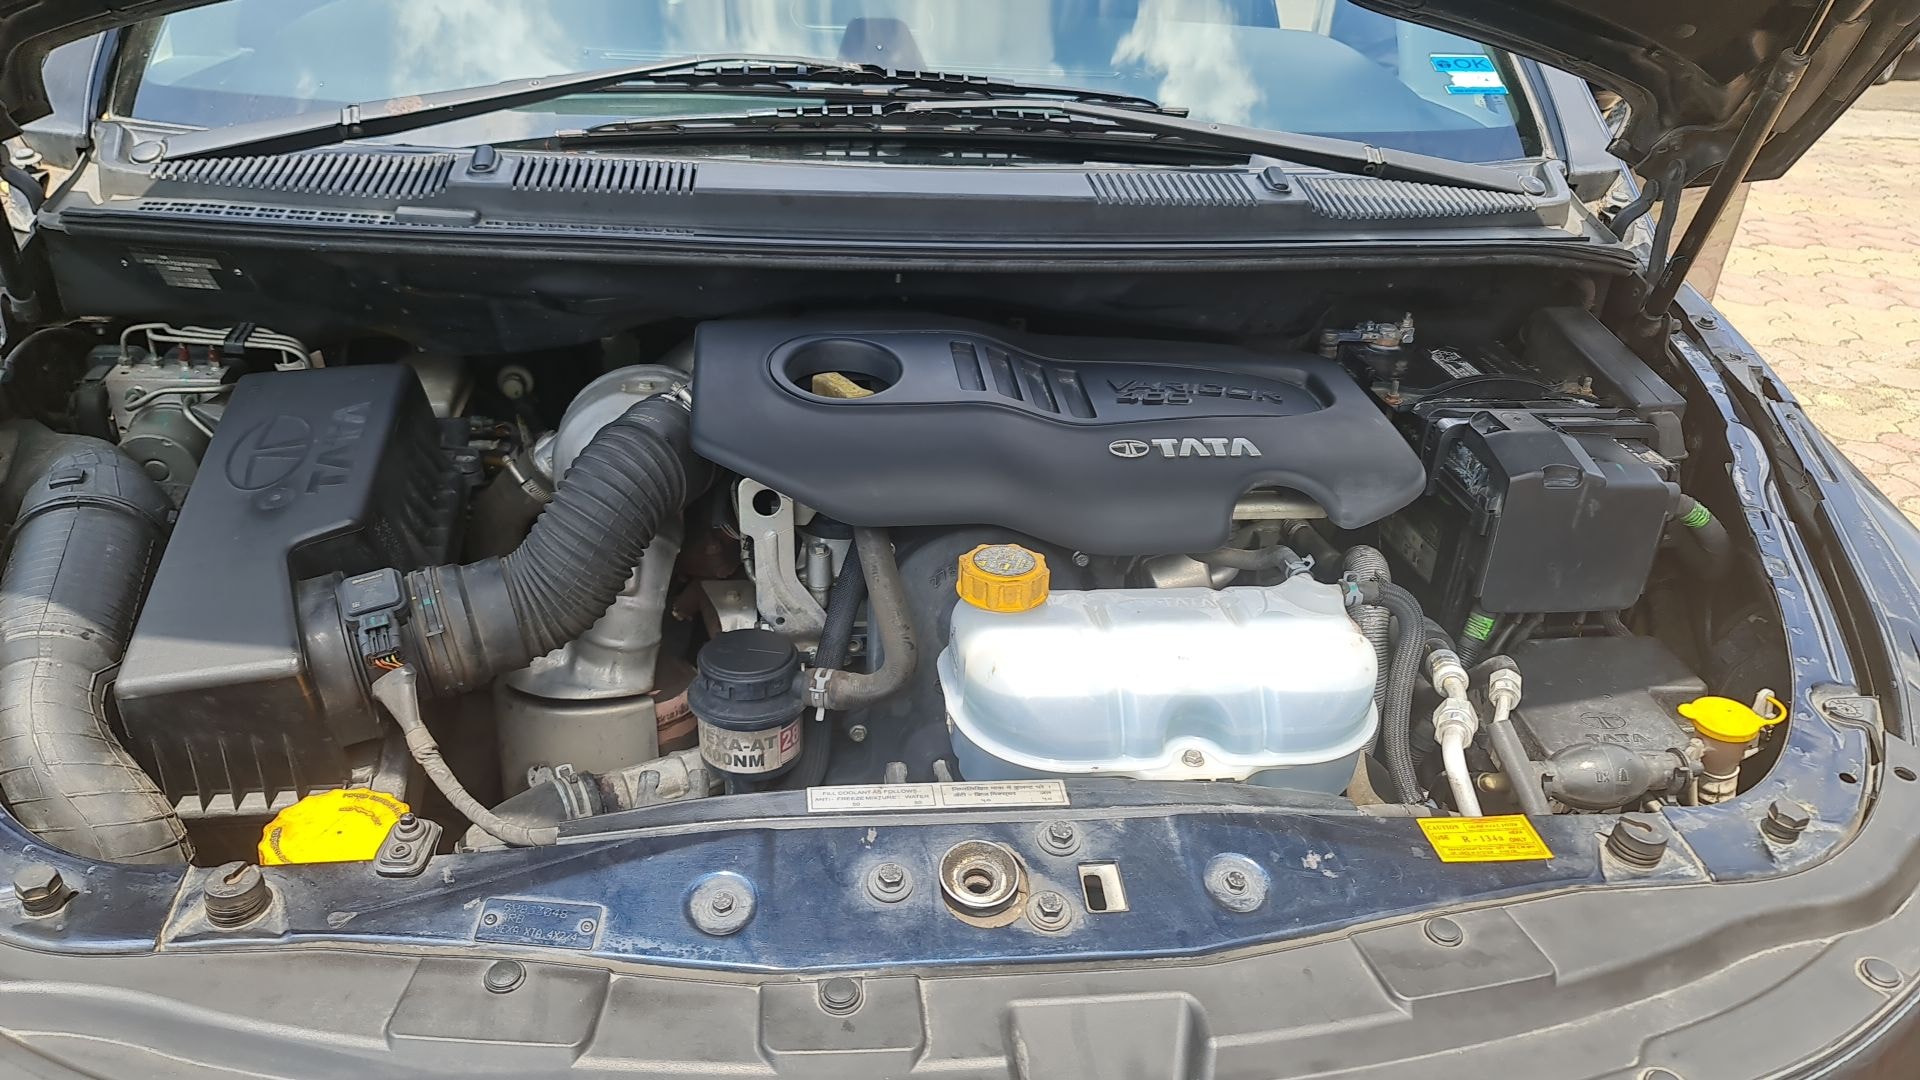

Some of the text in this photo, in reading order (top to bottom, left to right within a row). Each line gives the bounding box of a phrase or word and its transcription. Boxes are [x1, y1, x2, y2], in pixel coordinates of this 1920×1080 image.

[1453, 58, 1490, 69] OK
[1116, 392, 1193, 405] 400
[1151, 437, 1262, 458] TATA
[1585, 733, 1651, 743] TATA
